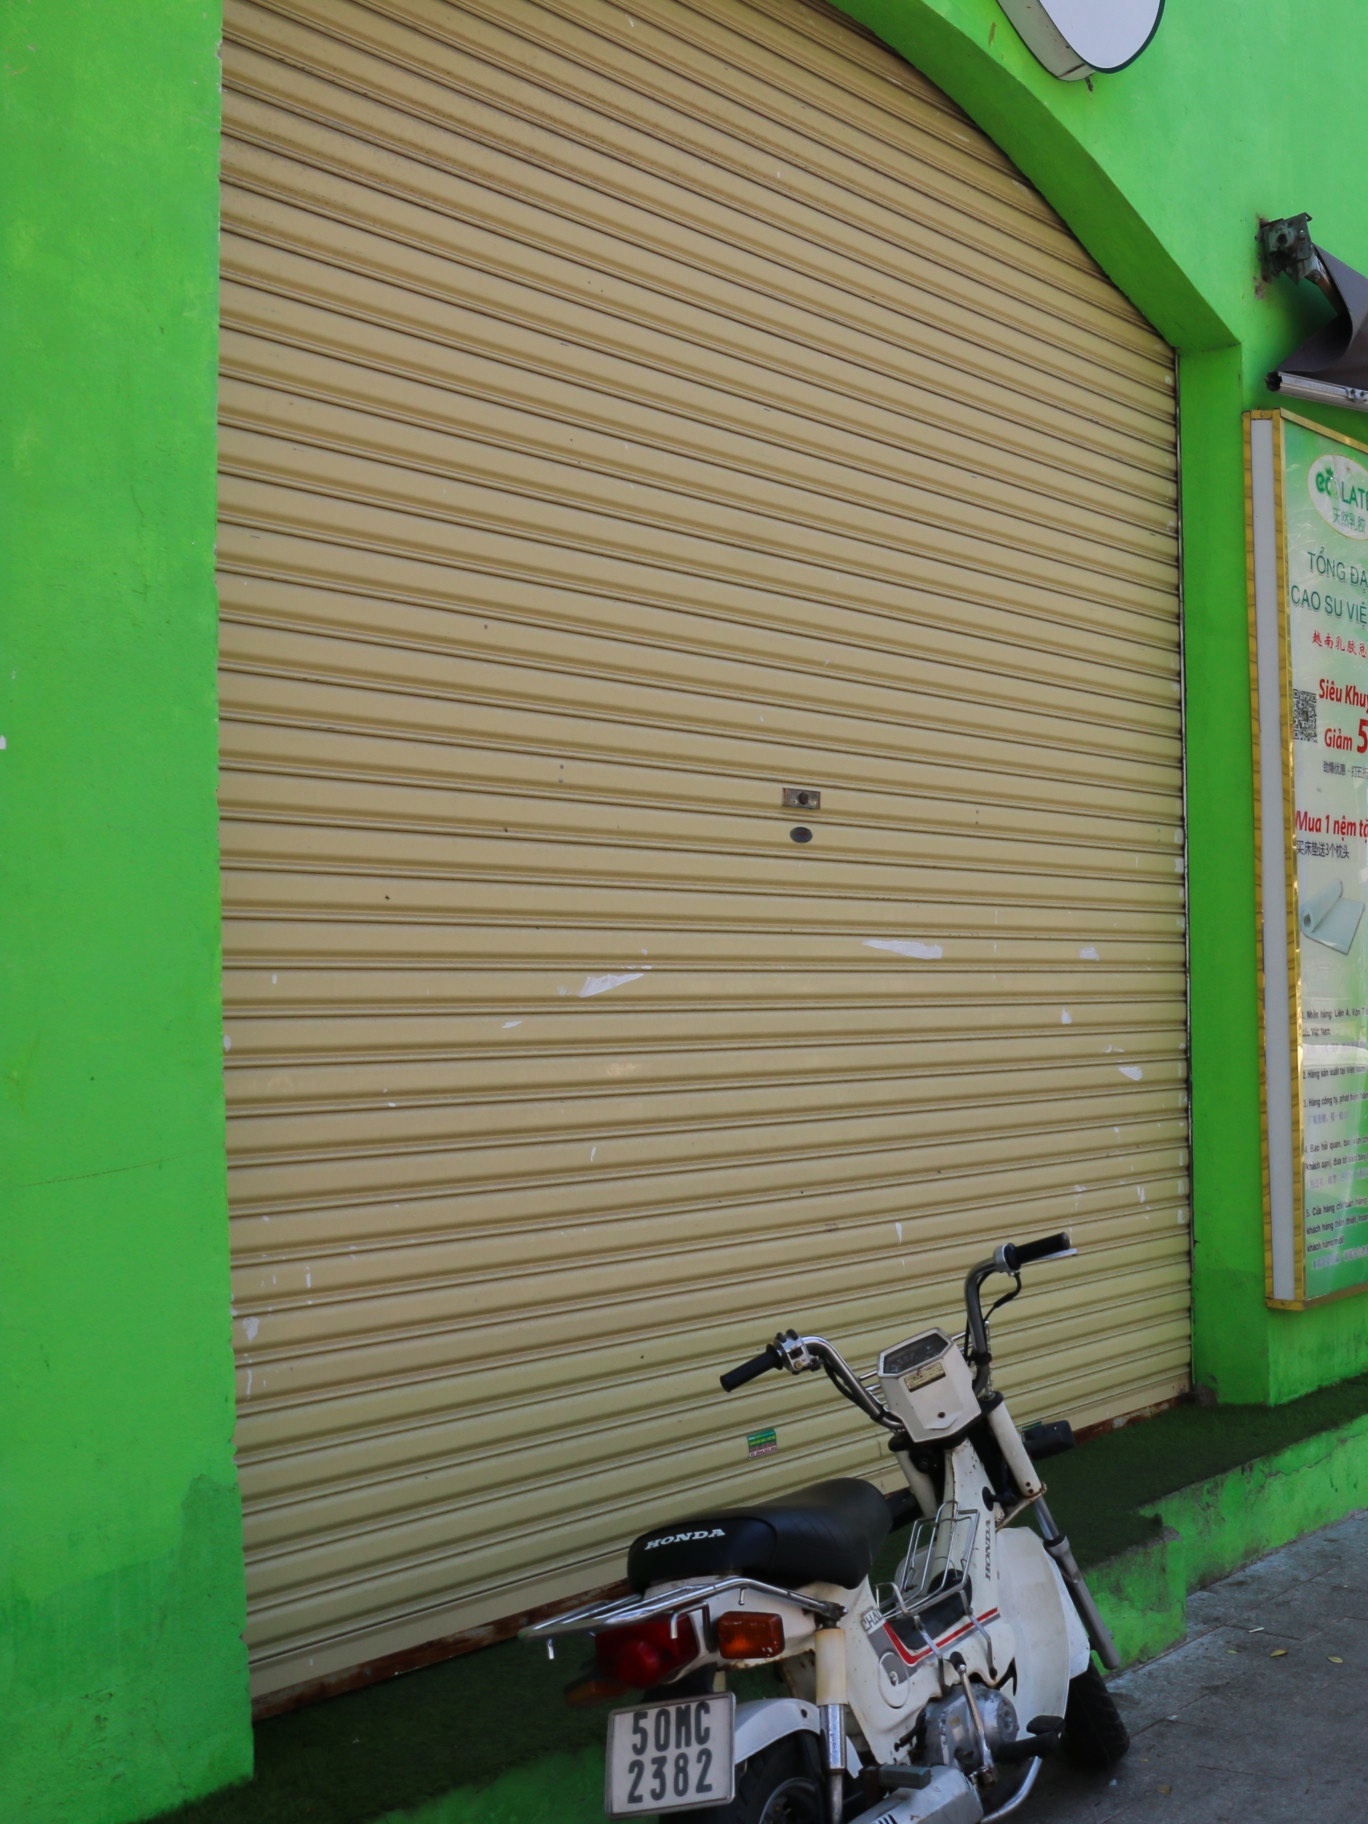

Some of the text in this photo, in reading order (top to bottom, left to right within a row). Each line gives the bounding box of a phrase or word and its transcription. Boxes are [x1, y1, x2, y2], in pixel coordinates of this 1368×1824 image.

[1307, 547, 1346, 581] TỔNG
[1291, 584, 1321, 613] CAO
[1324, 597, 1343, 617] SU
[1319, 678, 1342, 702] Siêu
[1324, 728, 1353, 751] Giảm
[1295, 811, 1322, 833] Mua
[1325, 814, 1330, 834] 1
[1333, 815, 1357, 842] nệm
[644, 1528, 725, 1550] HONDA
[984, 1520, 992, 1581] HONDA
[632, 1701, 711, 1757] 50MC
[627, 1748, 713, 1804] 2382
